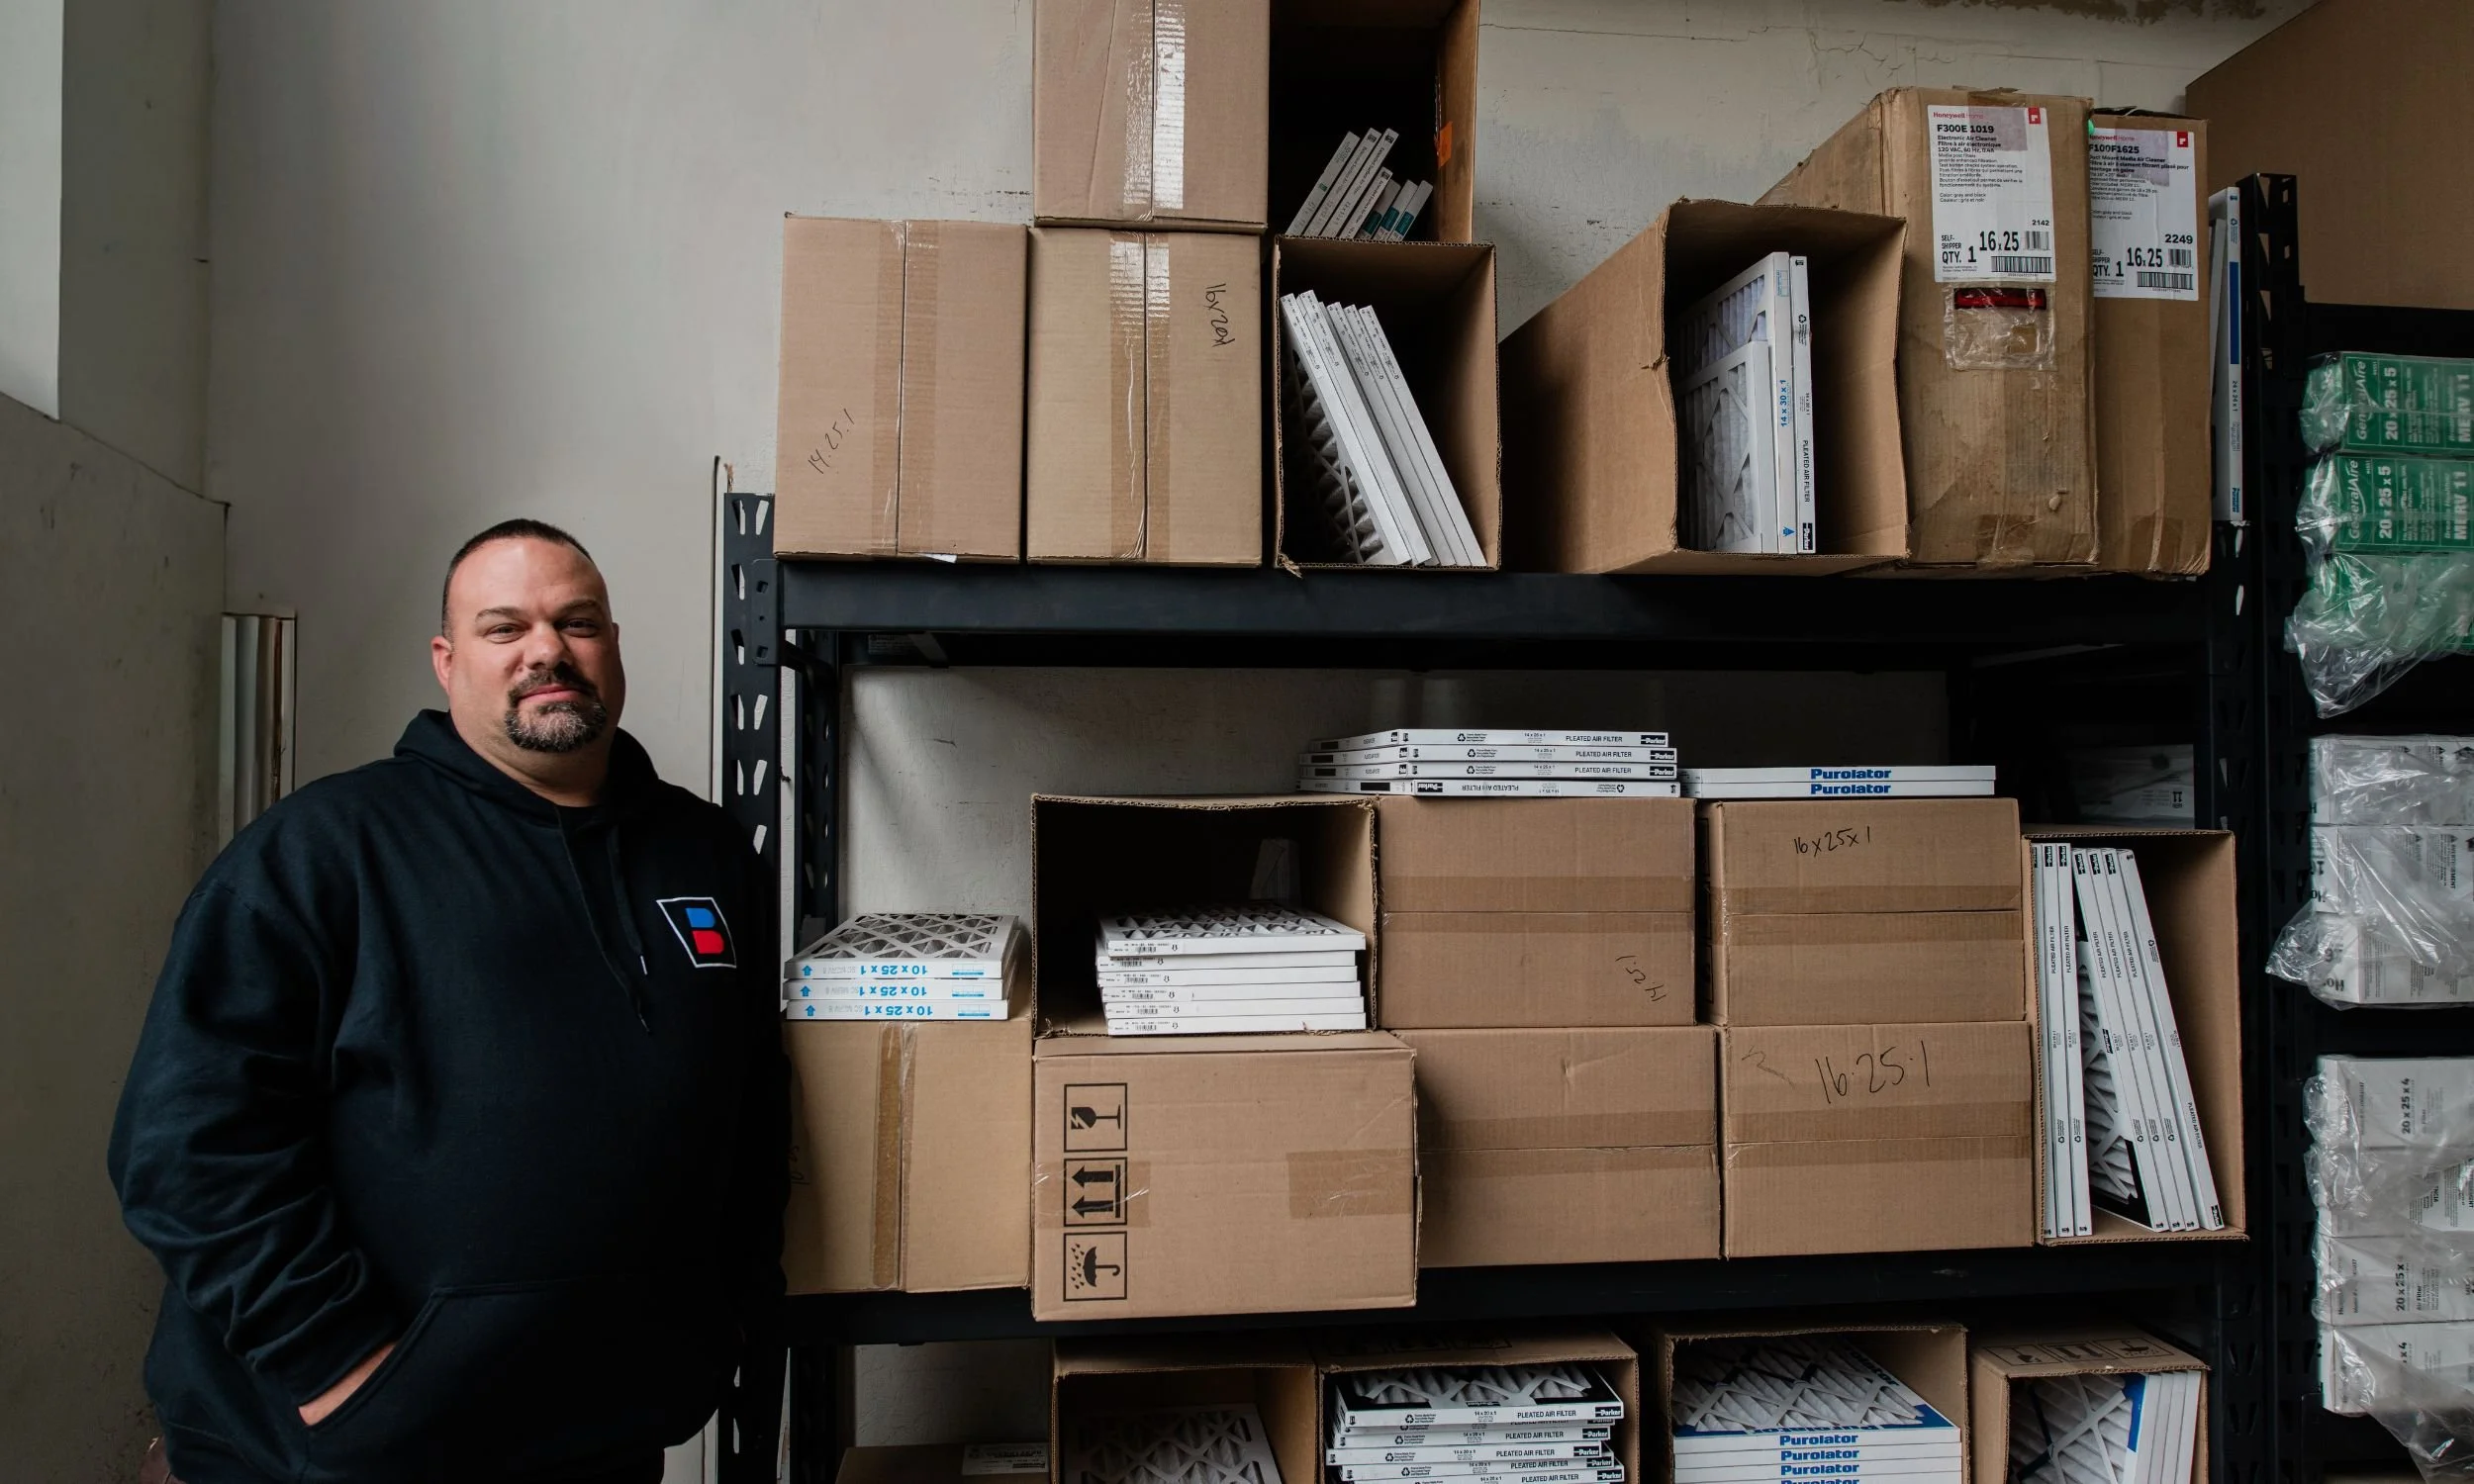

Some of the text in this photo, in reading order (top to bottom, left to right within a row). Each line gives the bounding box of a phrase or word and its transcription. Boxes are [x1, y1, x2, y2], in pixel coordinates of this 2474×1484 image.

[1970, 125, 1994, 134] 1019
[2165, 233, 2193, 244] 2249
[1942, 245, 1977, 264] QTY. 1
[2115, 260, 2125, 277] 1
[2384, 367, 2397, 377] 5
[1780, 395, 1788, 408] 30
[2384, 389, 2398, 409] 25
[1780, 417, 1788, 427] 14
[2386, 420, 2399, 441] 20
[2378, 465, 2391, 476] 5
[2379, 488, 2393, 508] 25
[2380, 518, 2393, 539] 20
[1810, 768, 1892, 780] Purolator
[1810, 783, 1891, 795] Purolator
[860, 965, 867, 975] 1
[881, 965, 899, 975] 25
[911, 965, 928, 975] 10
[859, 986, 865, 996] 1
[880, 986, 898, 996] 25
[911, 986, 927, 996] 10
[864, 1005, 934, 1016] 10 x 25 x 1
[2401, 1077, 2411, 1086] 4
[2401, 1096, 2411, 1110] 25
[2401, 1120, 2411, 1135] 20
[2395, 1272, 2406, 1287] 25
[2395, 1297, 2406, 1312] 20
[1779, 1435, 1858, 1446] Purolator
[1780, 1449, 1859, 1461] Purolator
[1780, 1464, 1859, 1476] Purolator
